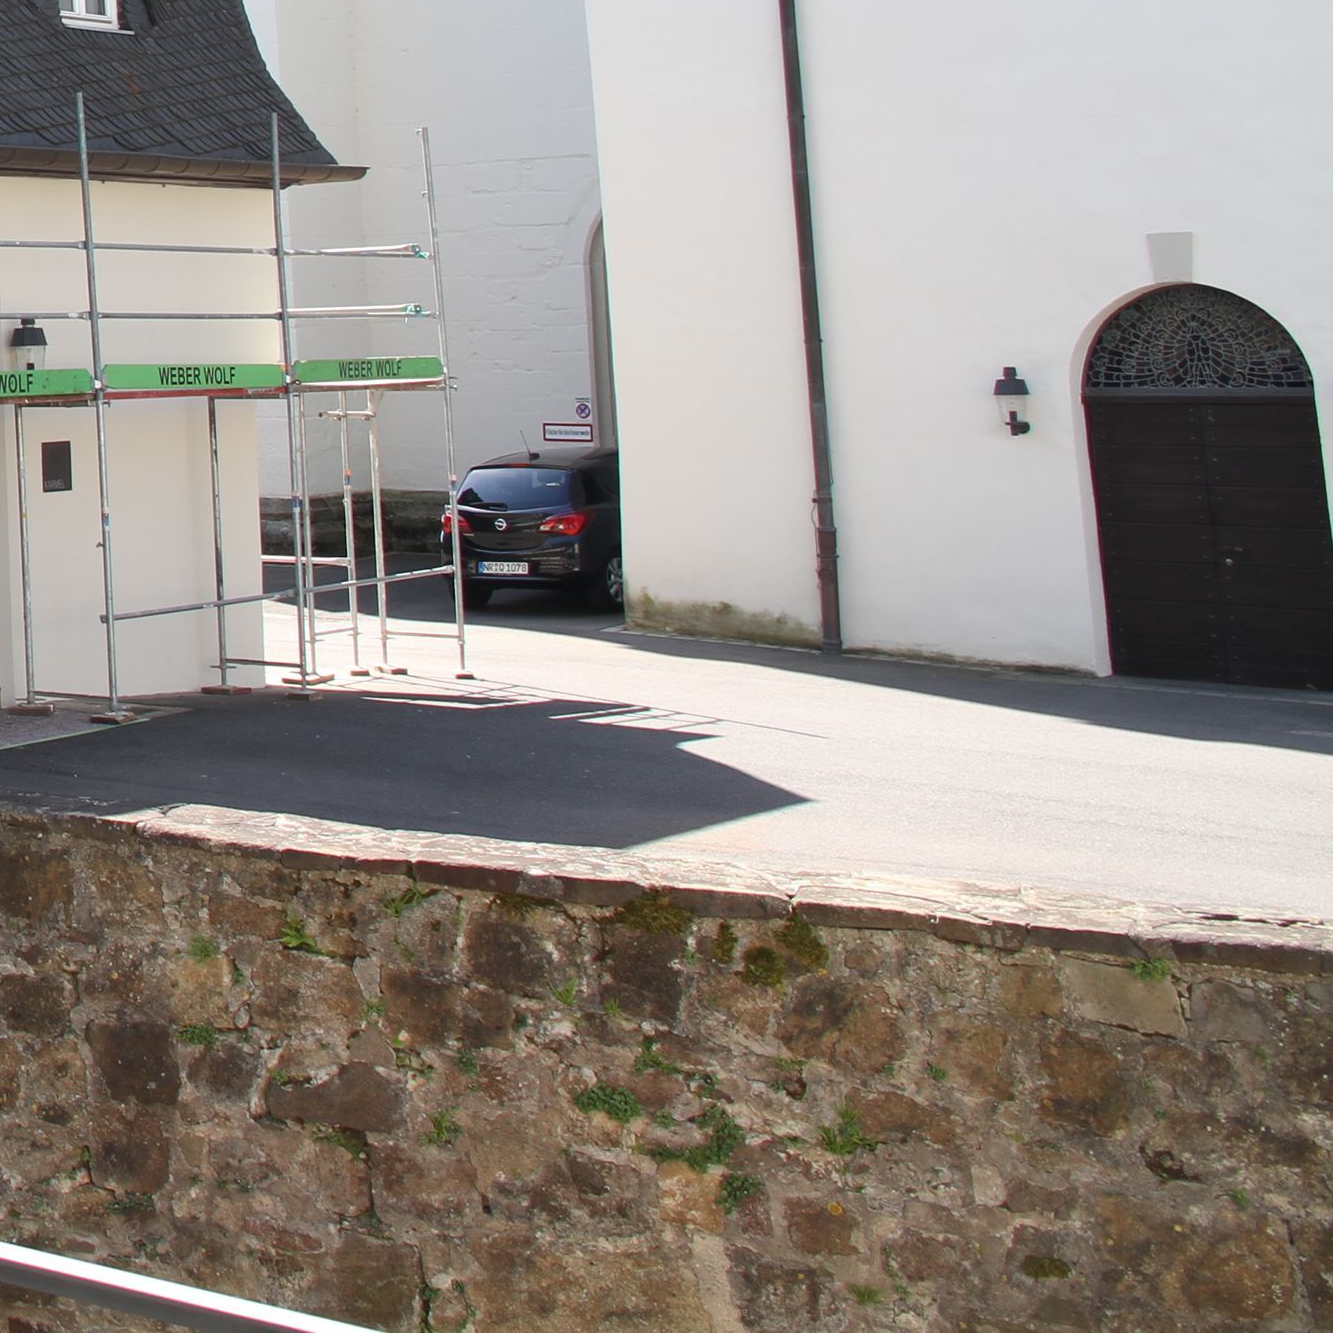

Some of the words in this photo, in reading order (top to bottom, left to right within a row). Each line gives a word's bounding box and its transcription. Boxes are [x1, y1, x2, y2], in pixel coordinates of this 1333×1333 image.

[158, 367, 201, 385] WEBER
[203, 366, 236, 385] WOLF
[338, 361, 373, 378] WEBER
[376, 360, 402, 377] WOLF
[506, 563, 527, 573] 1078
